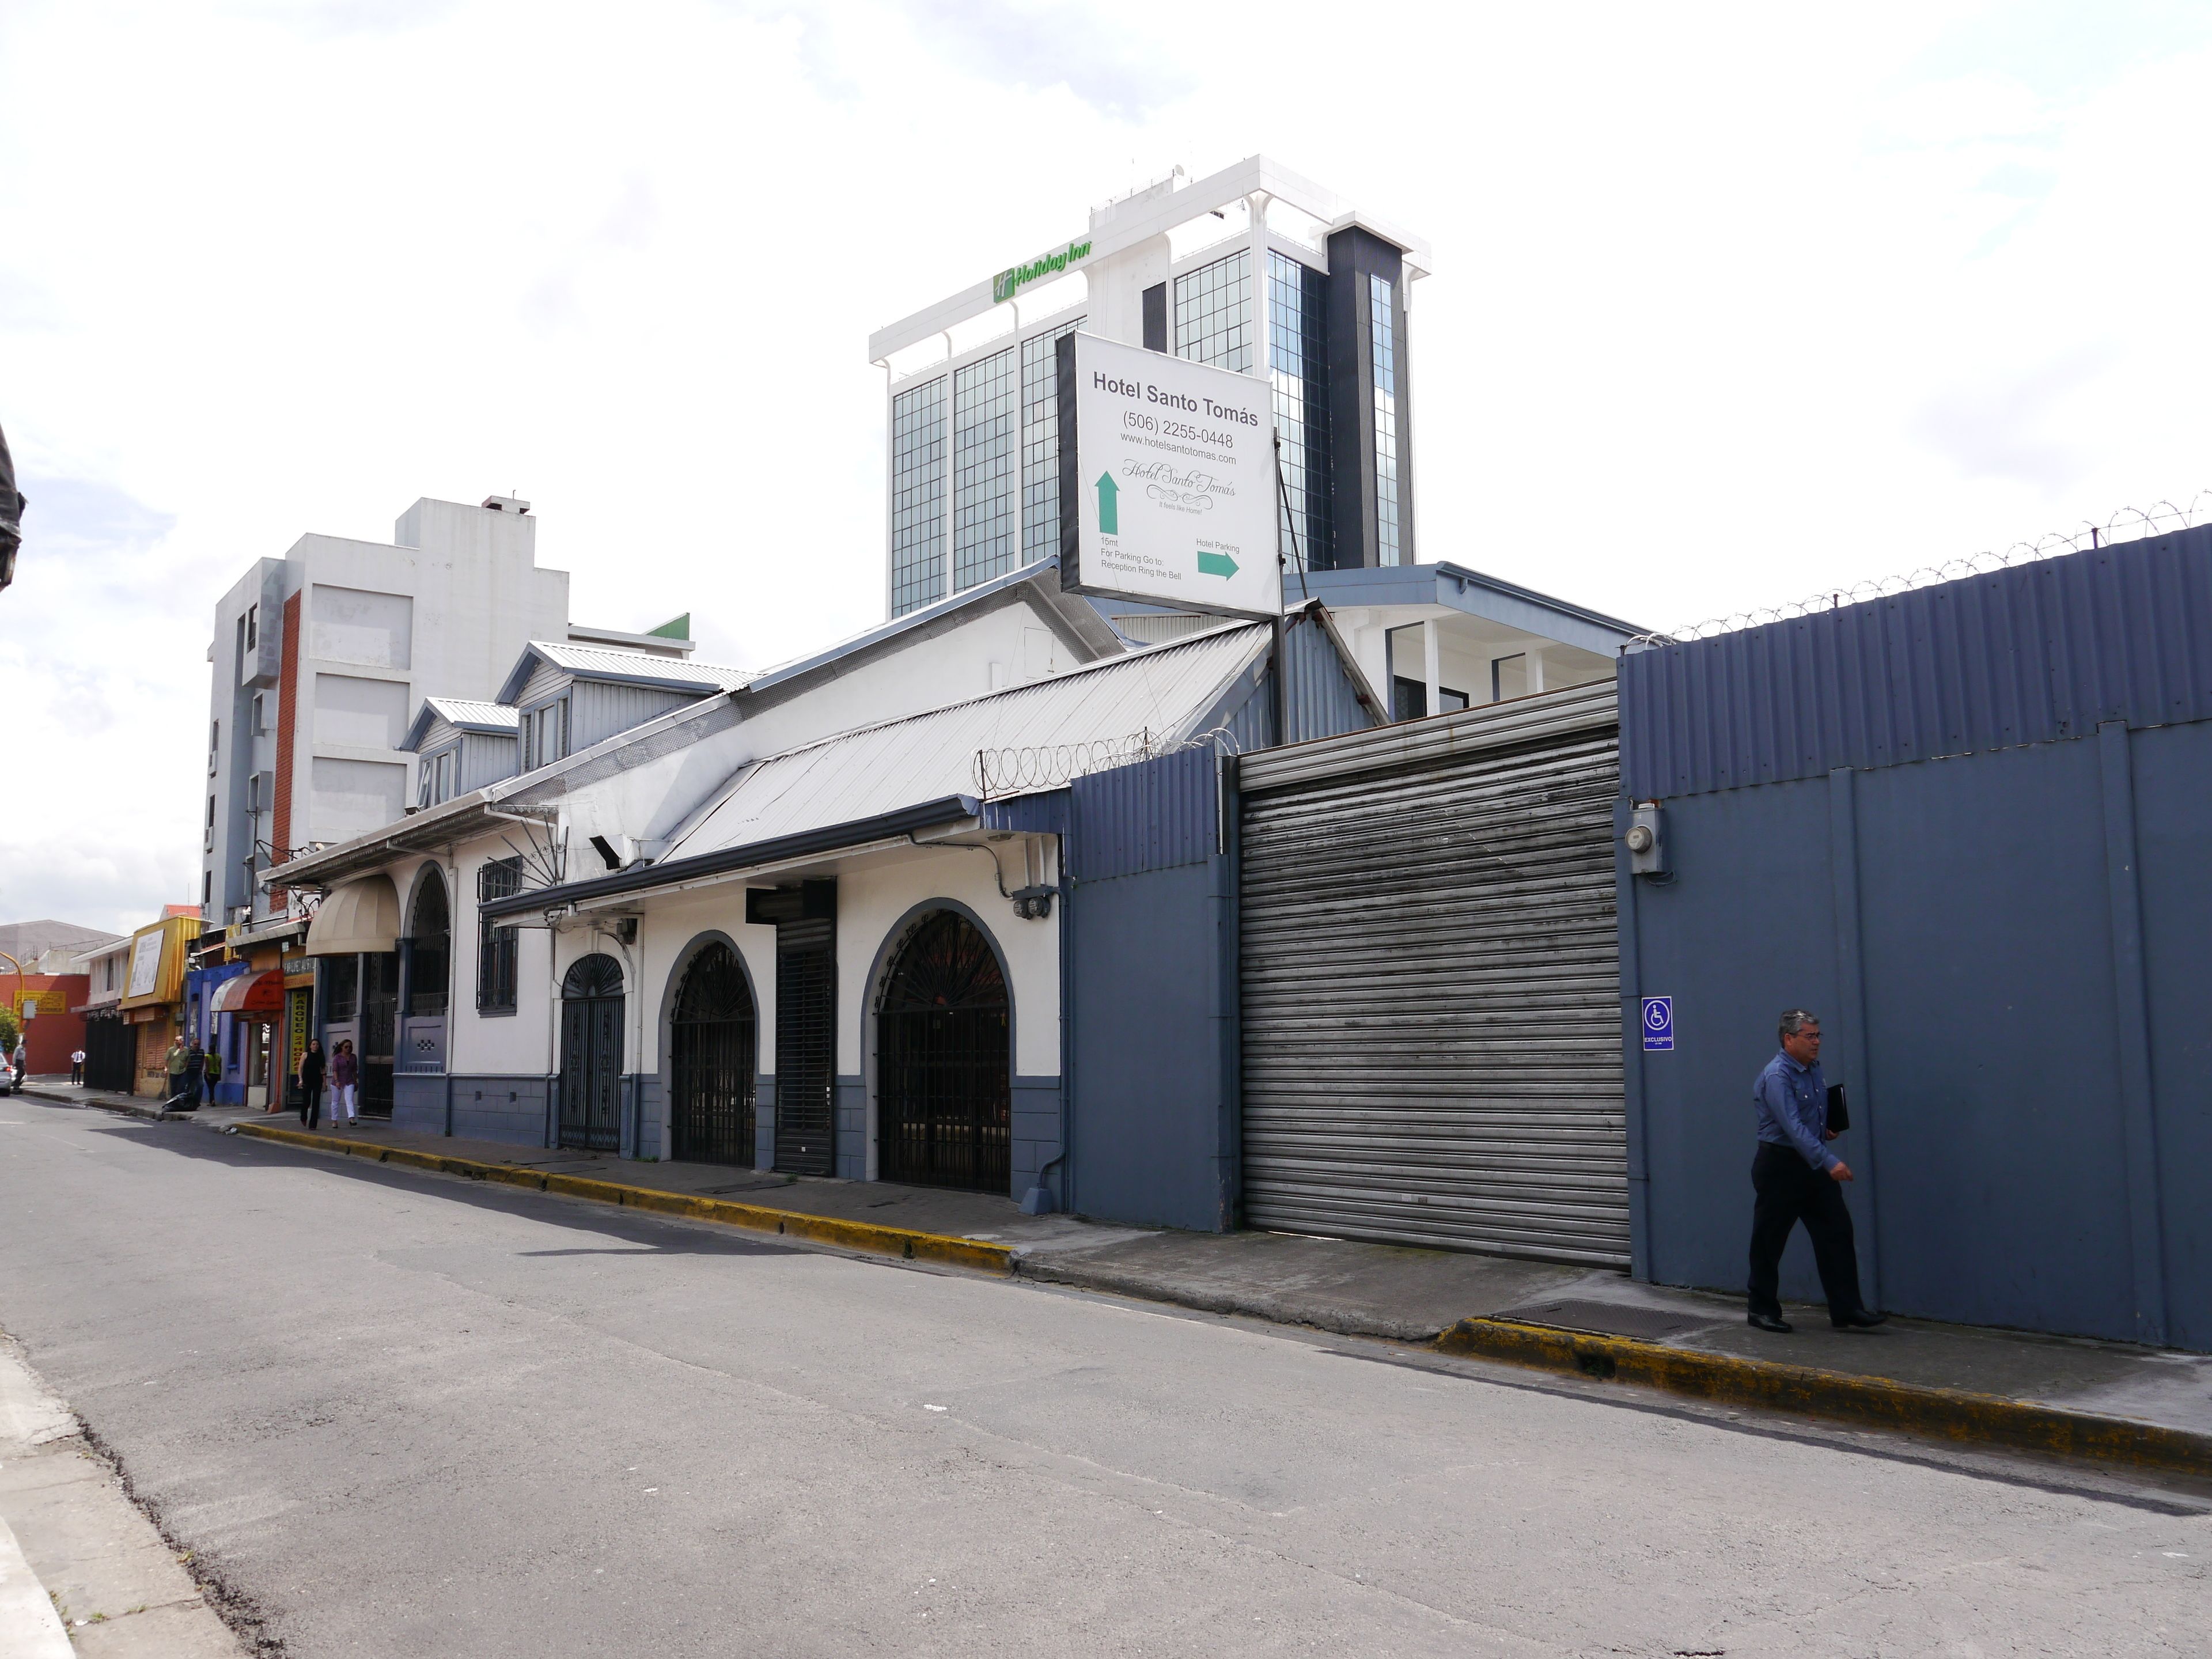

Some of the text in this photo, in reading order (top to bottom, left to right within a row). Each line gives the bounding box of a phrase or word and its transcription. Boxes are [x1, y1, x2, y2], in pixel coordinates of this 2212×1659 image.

[1016, 252, 1067, 286] Holiday
[1067, 243, 1091, 263] Inn
[1094, 371, 1258, 426] Hotel Santo Tomás
[1123, 411, 1233, 448] (506) 2255-0448
[1120, 433, 1236, 465] www.hotelsantotomas.com
[1122, 459, 1236, 496] Hotel Santo Tomás
[1164, 502, 1176, 510] feels
[1176, 504, 1185, 512] like
[1186, 506, 1202, 515] Home!
[1101, 536, 1119, 547] 15mt
[1196, 538, 1240, 554] Hotel Parking
[1101, 548, 1164, 566] For Parking Go to:
[1101, 559, 1181, 580] Reception Ring the Bell
[294, 993, 305, 1033] PARQUEO
[294, 1036, 303, 1046] 24
